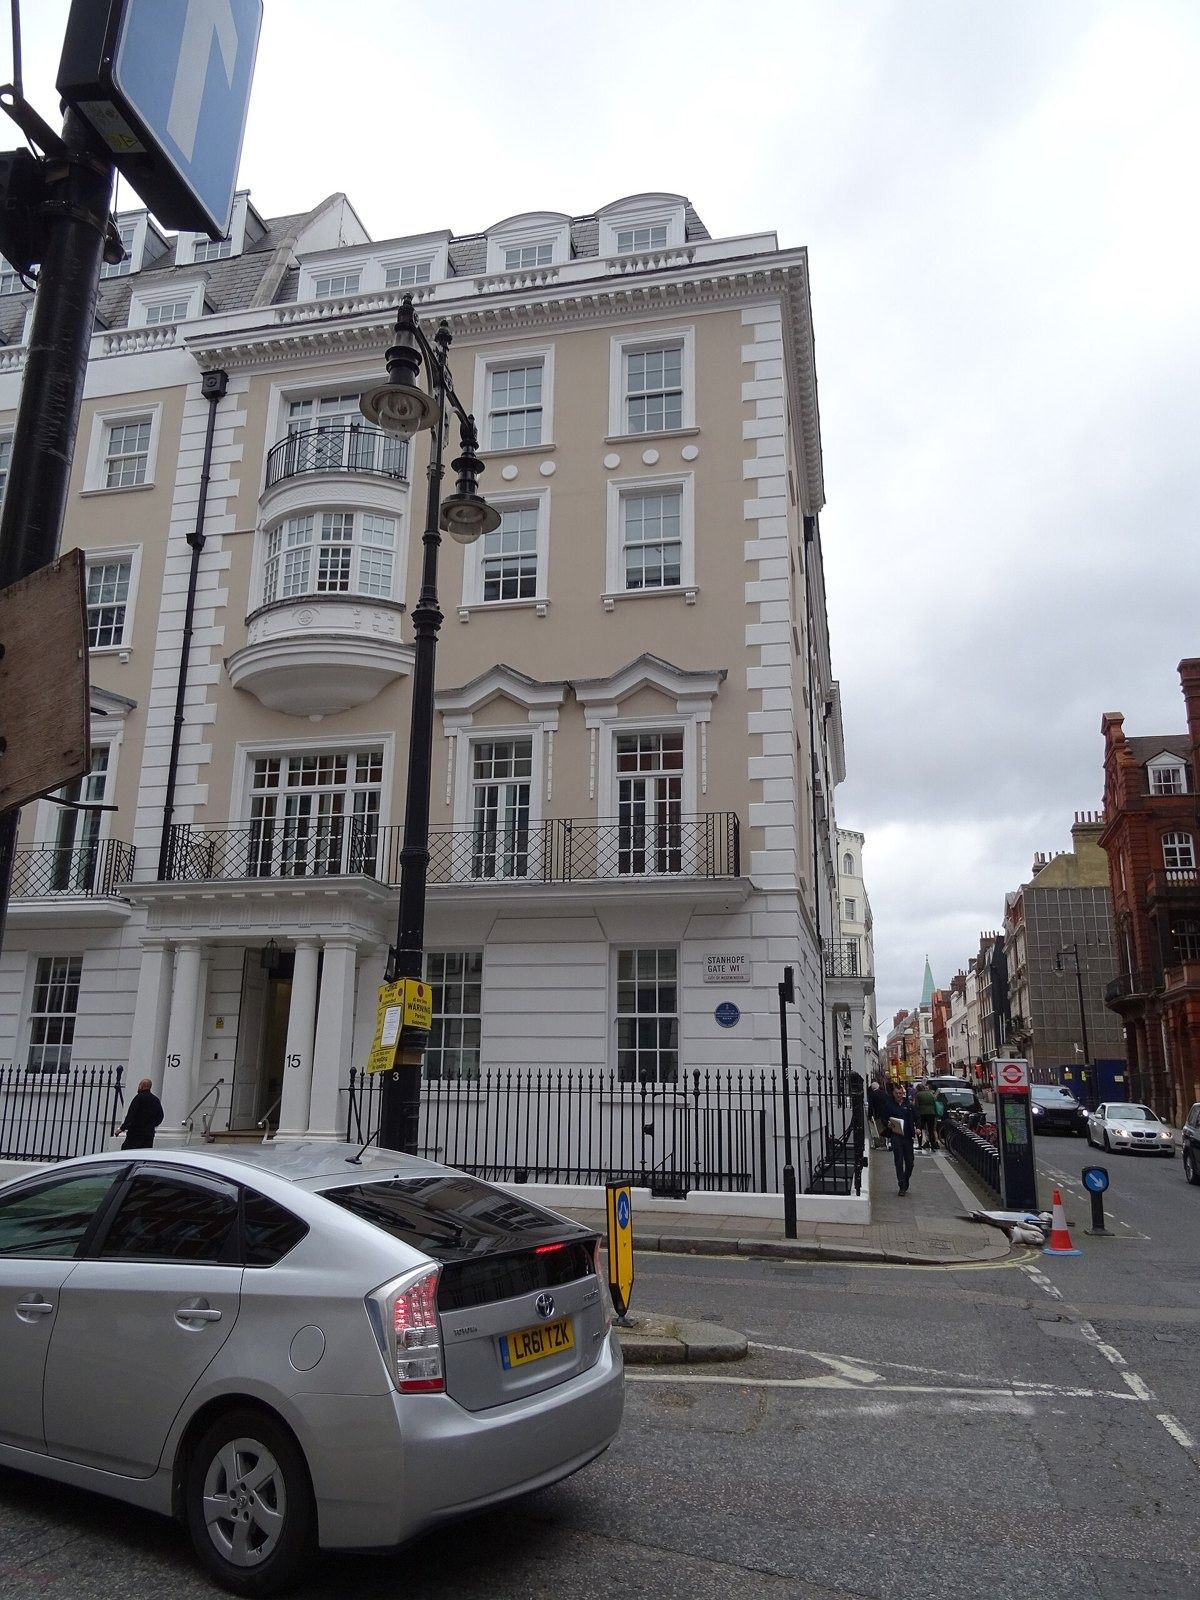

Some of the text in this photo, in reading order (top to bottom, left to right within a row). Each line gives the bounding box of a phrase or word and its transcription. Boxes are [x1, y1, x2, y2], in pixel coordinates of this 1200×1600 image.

[707, 955, 745, 964] STANHOPE
[707, 965, 726, 973] GATE
[407, 1002, 431, 1014] WARNING
[166, 1054, 181, 1068] 15
[286, 1054, 302, 1068] 15
[392, 1071, 400, 1081] 3
[513, 1321, 570, 1360] LR61 TZK
